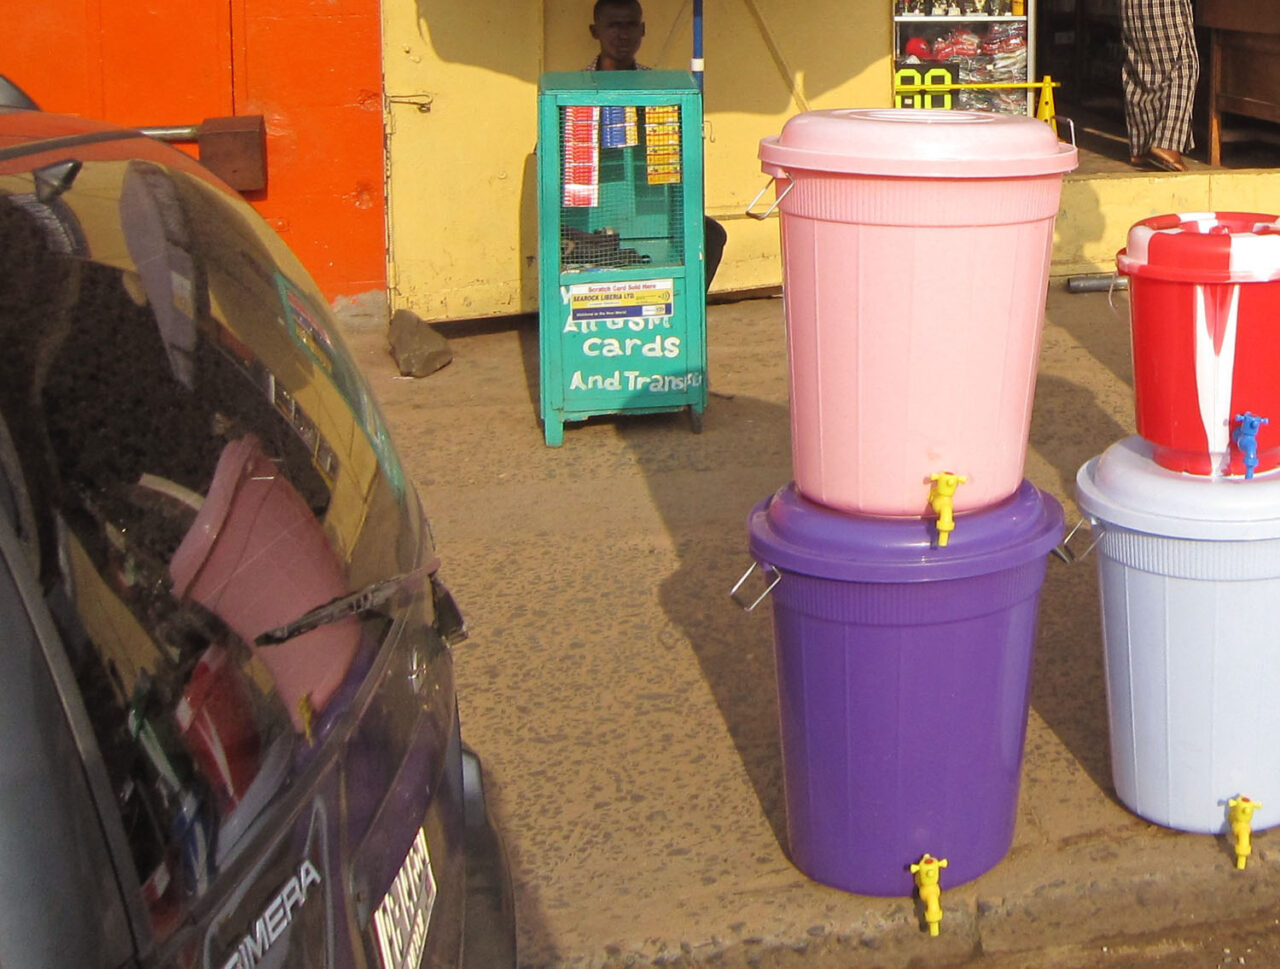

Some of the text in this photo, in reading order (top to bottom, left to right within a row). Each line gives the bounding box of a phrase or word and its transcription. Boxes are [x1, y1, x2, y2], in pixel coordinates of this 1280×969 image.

[601, 293, 622, 301] LIBERIA
[582, 334, 681, 358] cards
[570, 370, 622, 391] And
